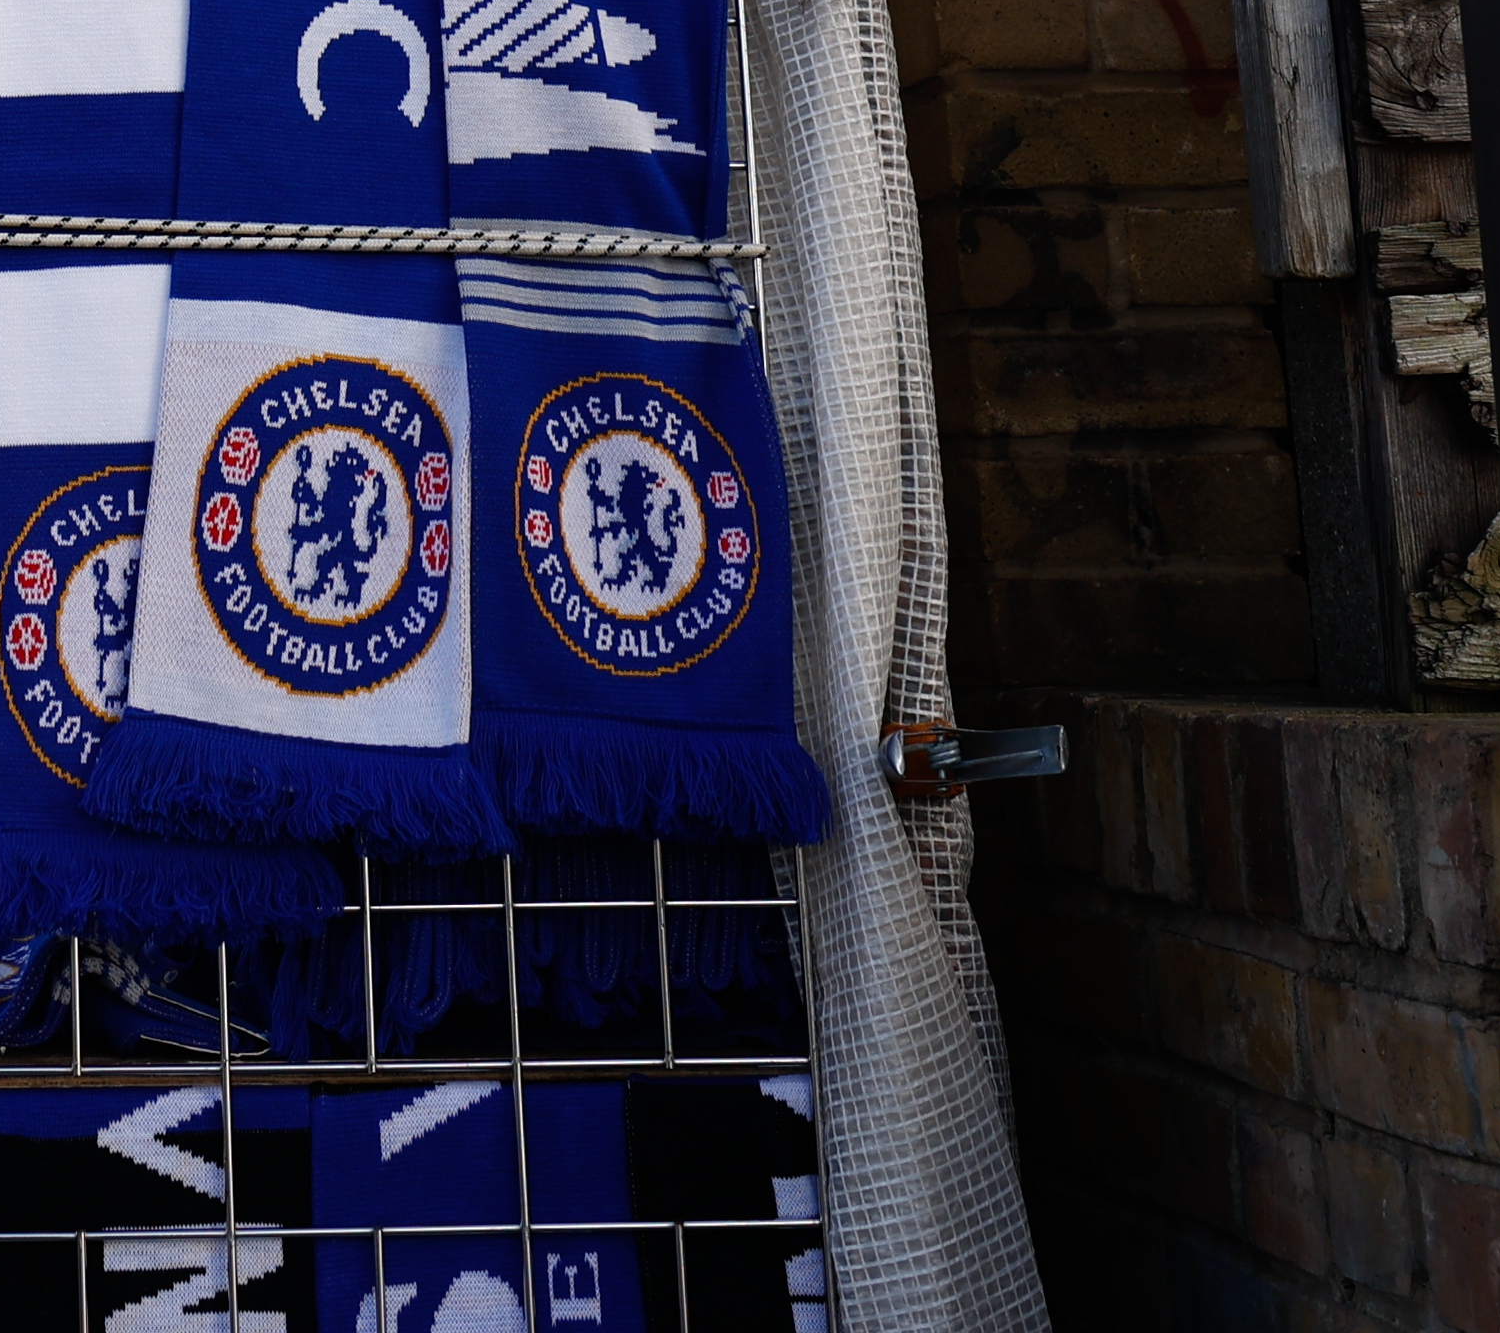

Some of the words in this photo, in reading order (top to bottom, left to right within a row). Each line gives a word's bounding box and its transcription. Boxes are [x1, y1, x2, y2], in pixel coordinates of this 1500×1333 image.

[260, 379, 422, 448] CHELSEA
[545, 392, 699, 463] CHELSEA
[214, 562, 363, 676] FOOTBALL
[366, 585, 438, 664] CLUB
[536, 553, 675, 659] FOOTBALL
[676, 566, 745, 640] CLUB
